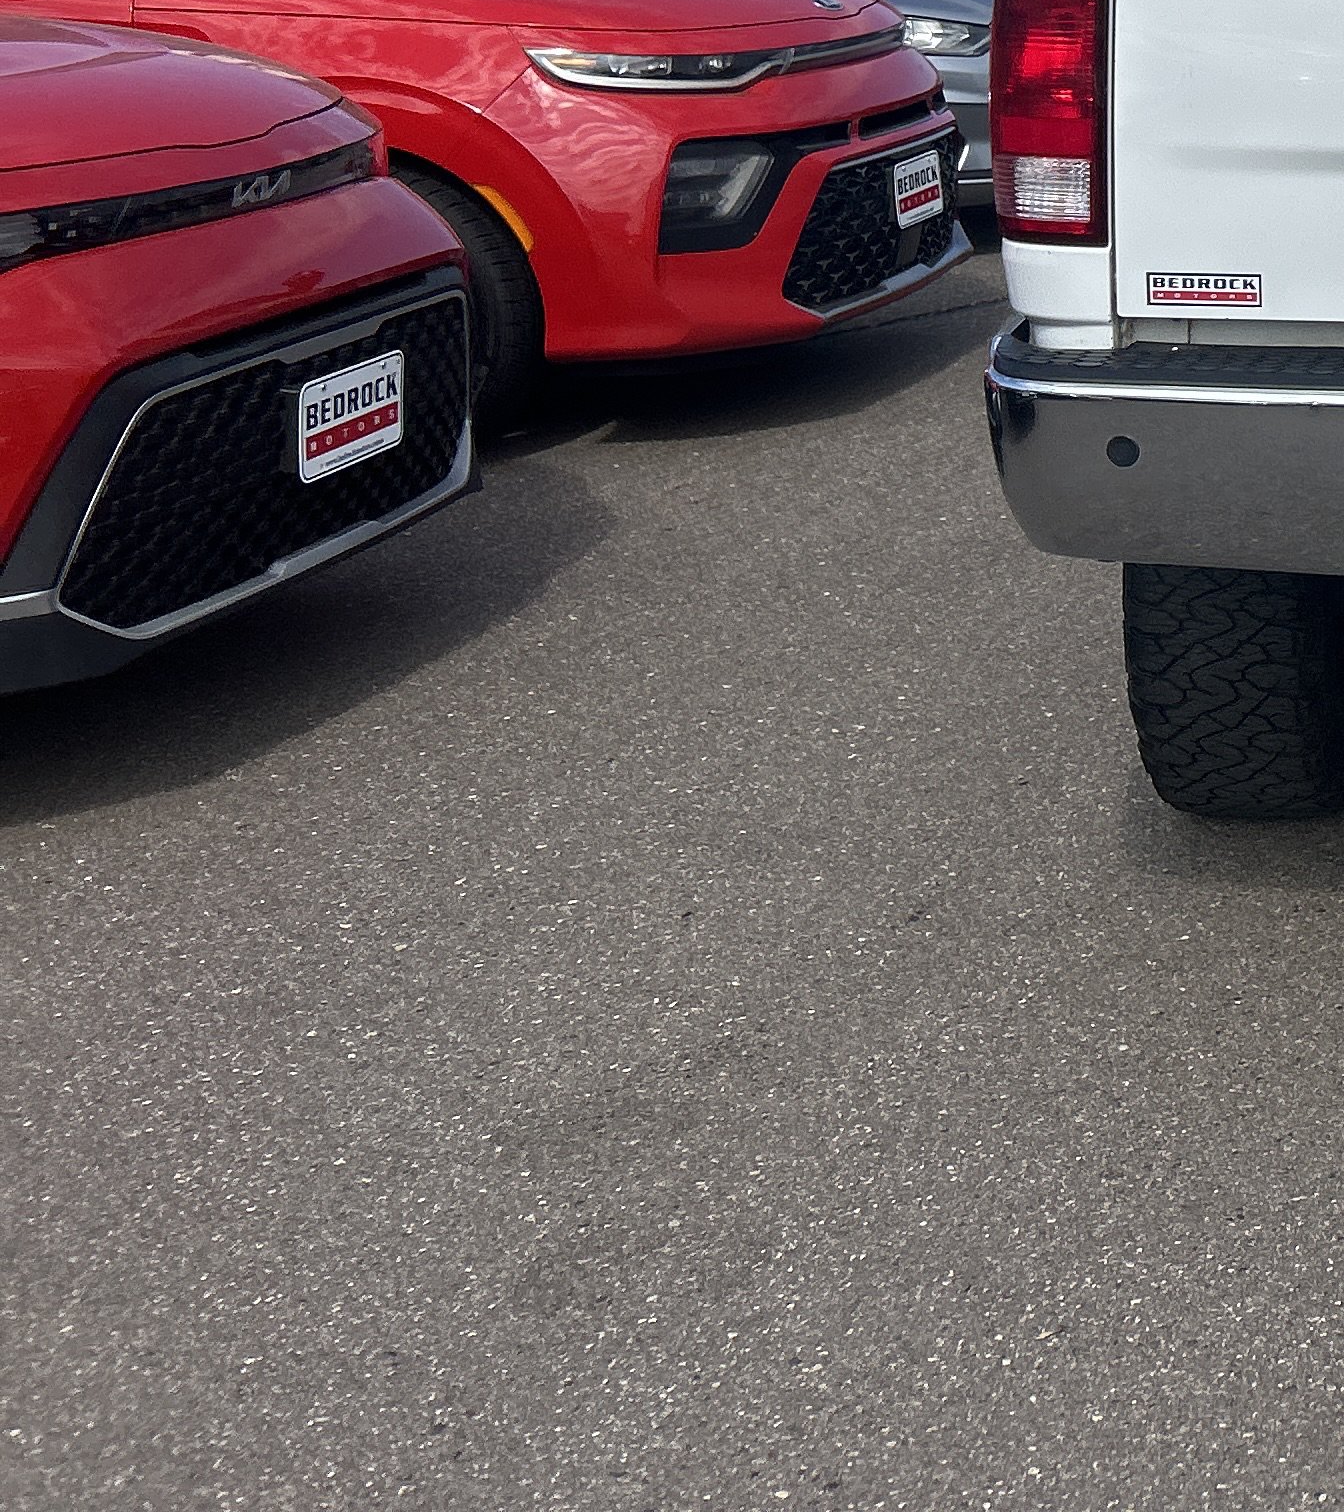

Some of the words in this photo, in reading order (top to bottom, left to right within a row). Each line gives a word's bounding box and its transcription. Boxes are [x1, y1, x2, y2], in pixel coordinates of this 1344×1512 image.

[898, 164, 938, 195] BEDROCK
[1153, 278, 1256, 289] BEDROCK
[305, 372, 398, 431] BEDROCK
